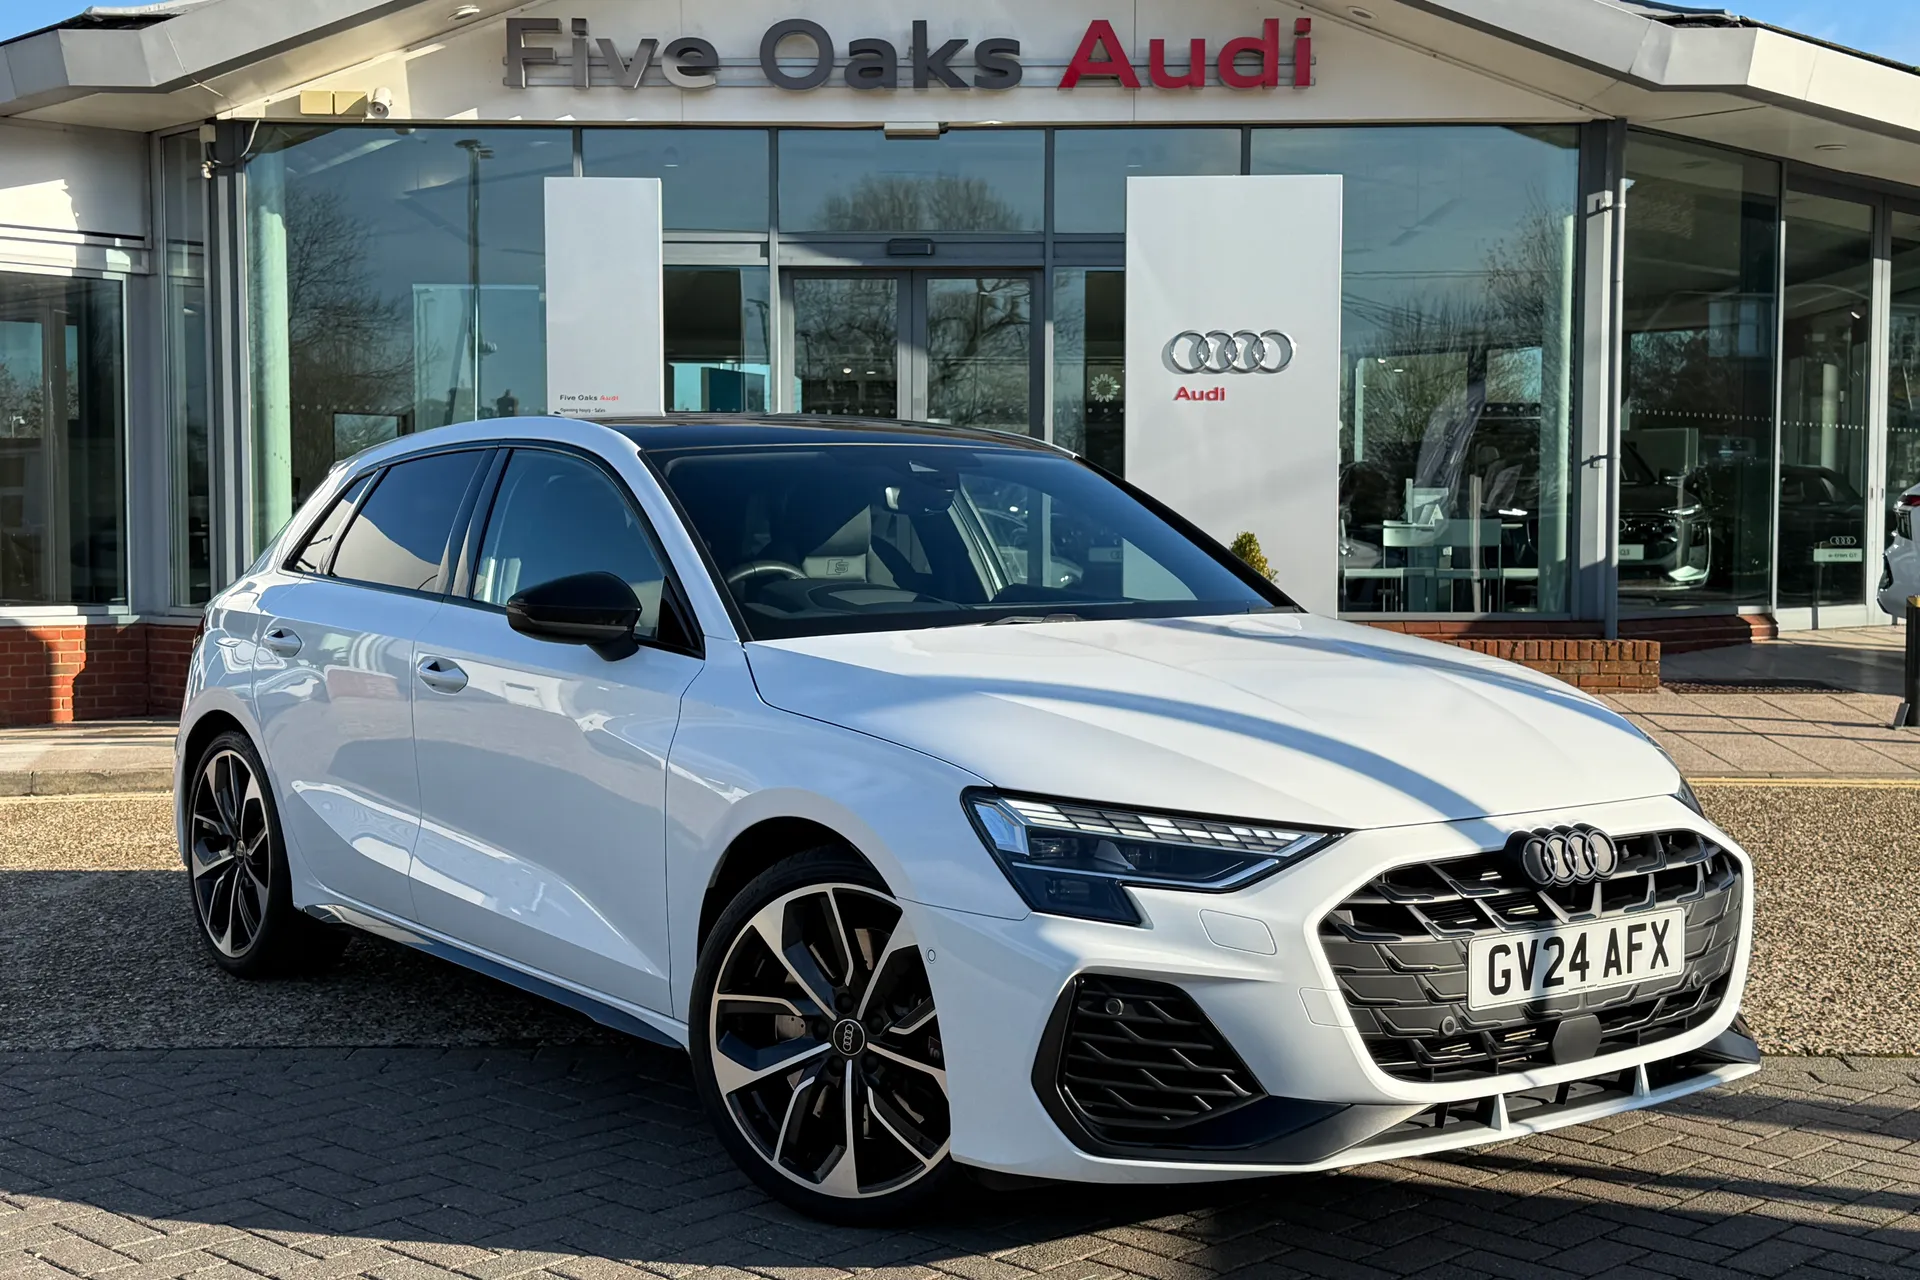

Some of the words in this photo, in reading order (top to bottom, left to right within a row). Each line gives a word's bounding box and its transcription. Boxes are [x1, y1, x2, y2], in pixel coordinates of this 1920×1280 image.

[506, 18, 721, 89] Five
[760, 18, 1023, 91] Oaks
[1058, 19, 1311, 89] Audi
[1172, 386, 1226, 401] Audi
[1488, 932, 1590, 996] GV24
[1603, 919, 1670, 978] AFX
